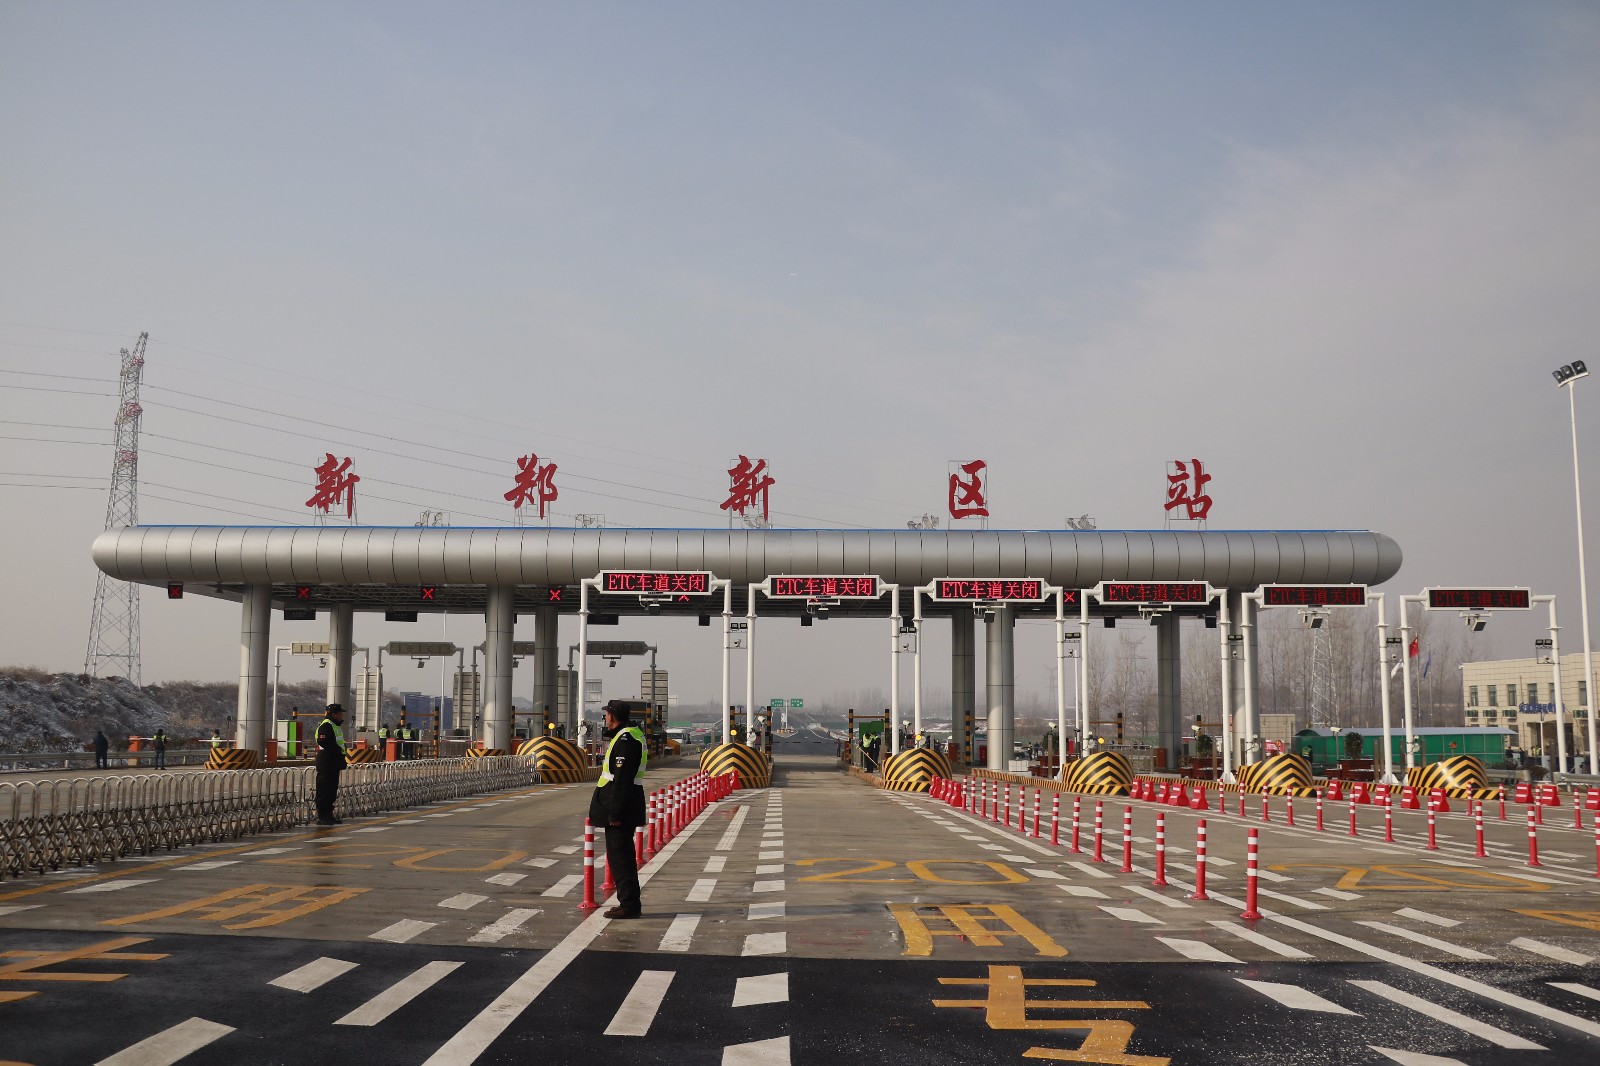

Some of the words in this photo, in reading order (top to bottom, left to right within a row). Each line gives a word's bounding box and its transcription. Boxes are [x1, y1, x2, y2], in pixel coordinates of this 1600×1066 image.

[306, 454, 1212, 519] 新郑新区站
[608, 573, 705, 592] ETC车道关闭
[775, 577, 874, 596] ETC车道关闭
[941, 580, 1039, 599] ETC车道关闭
[1109, 584, 1203, 602] ETC车道关闭
[1270, 587, 1361, 604] ETC车道关闭
[1435, 590, 1525, 607] ETC车道关闭
[795, 858, 1030, 884] 20
